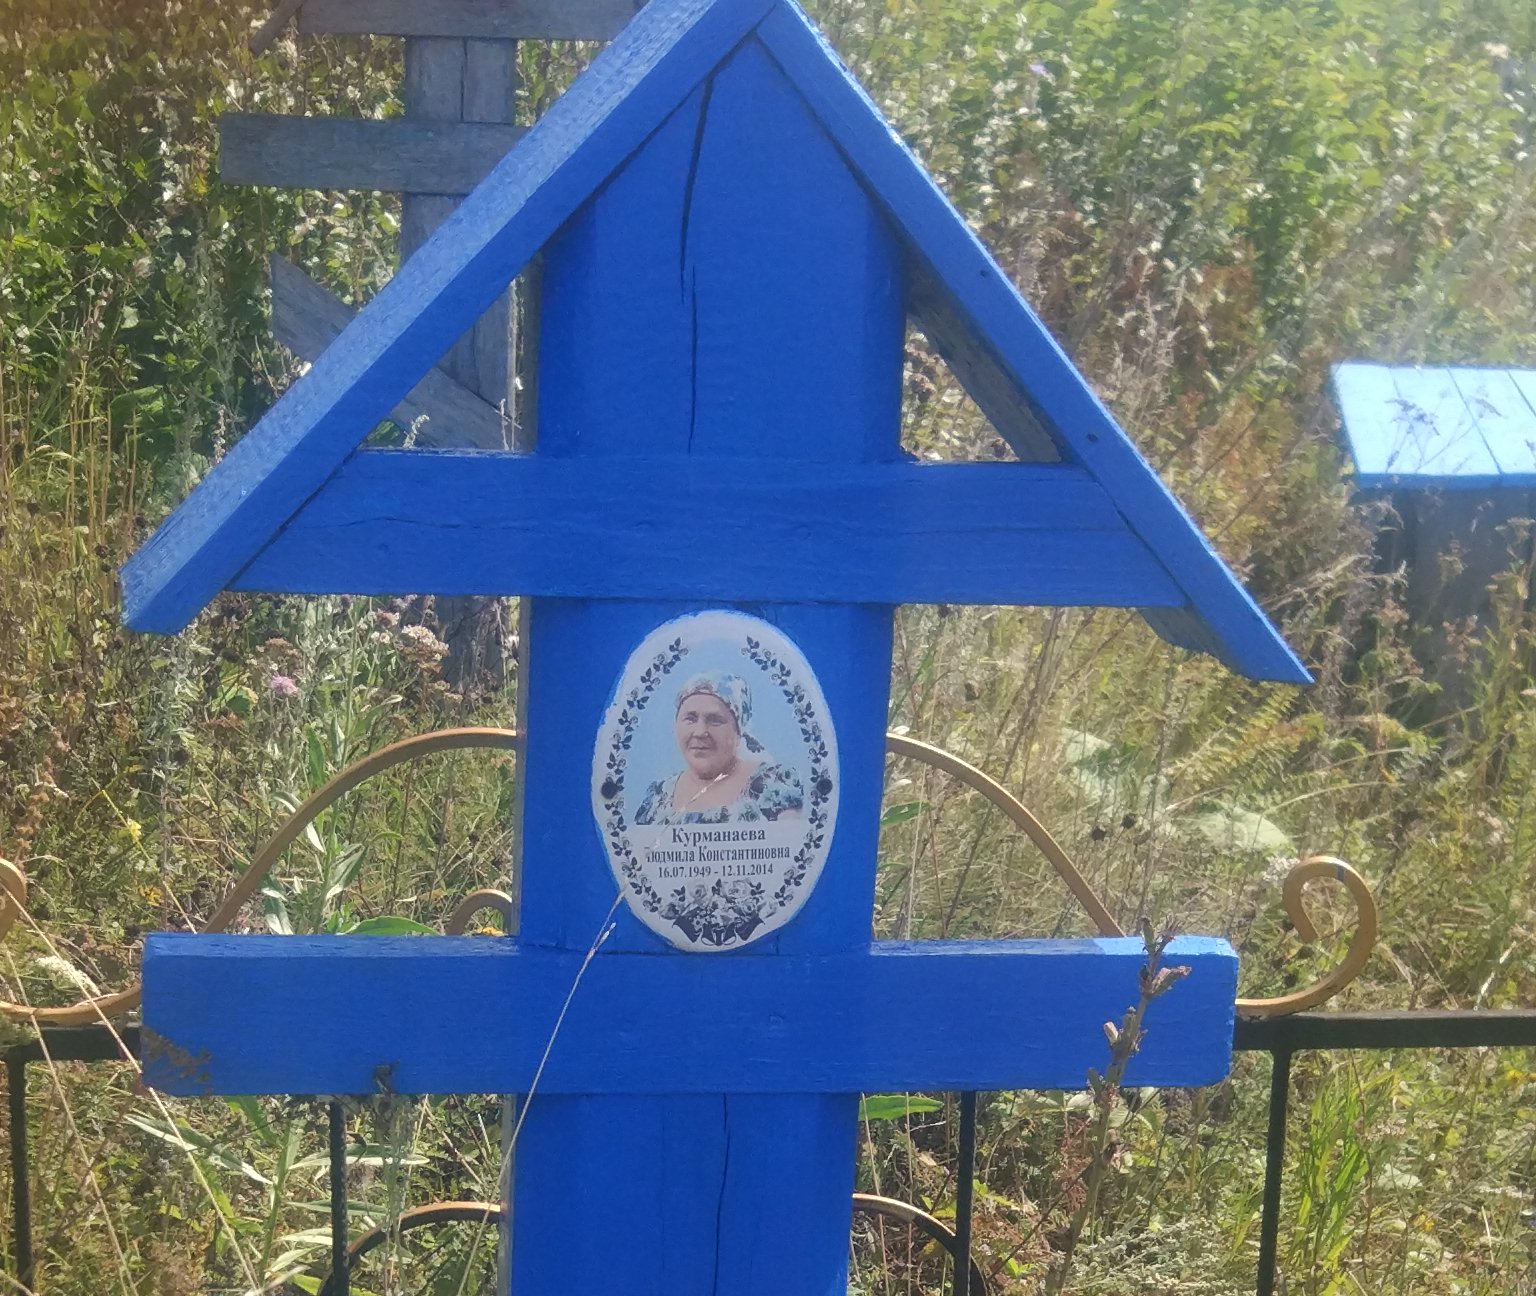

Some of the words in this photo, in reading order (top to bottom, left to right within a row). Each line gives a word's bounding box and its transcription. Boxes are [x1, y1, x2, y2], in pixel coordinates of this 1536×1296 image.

[671, 827, 766, 847] Курманаева
[698, 845, 790, 862] Константиновна
[658, 866, 711, 878] 16.07.1949
[721, 863, 774, 876] 12.11.2014
